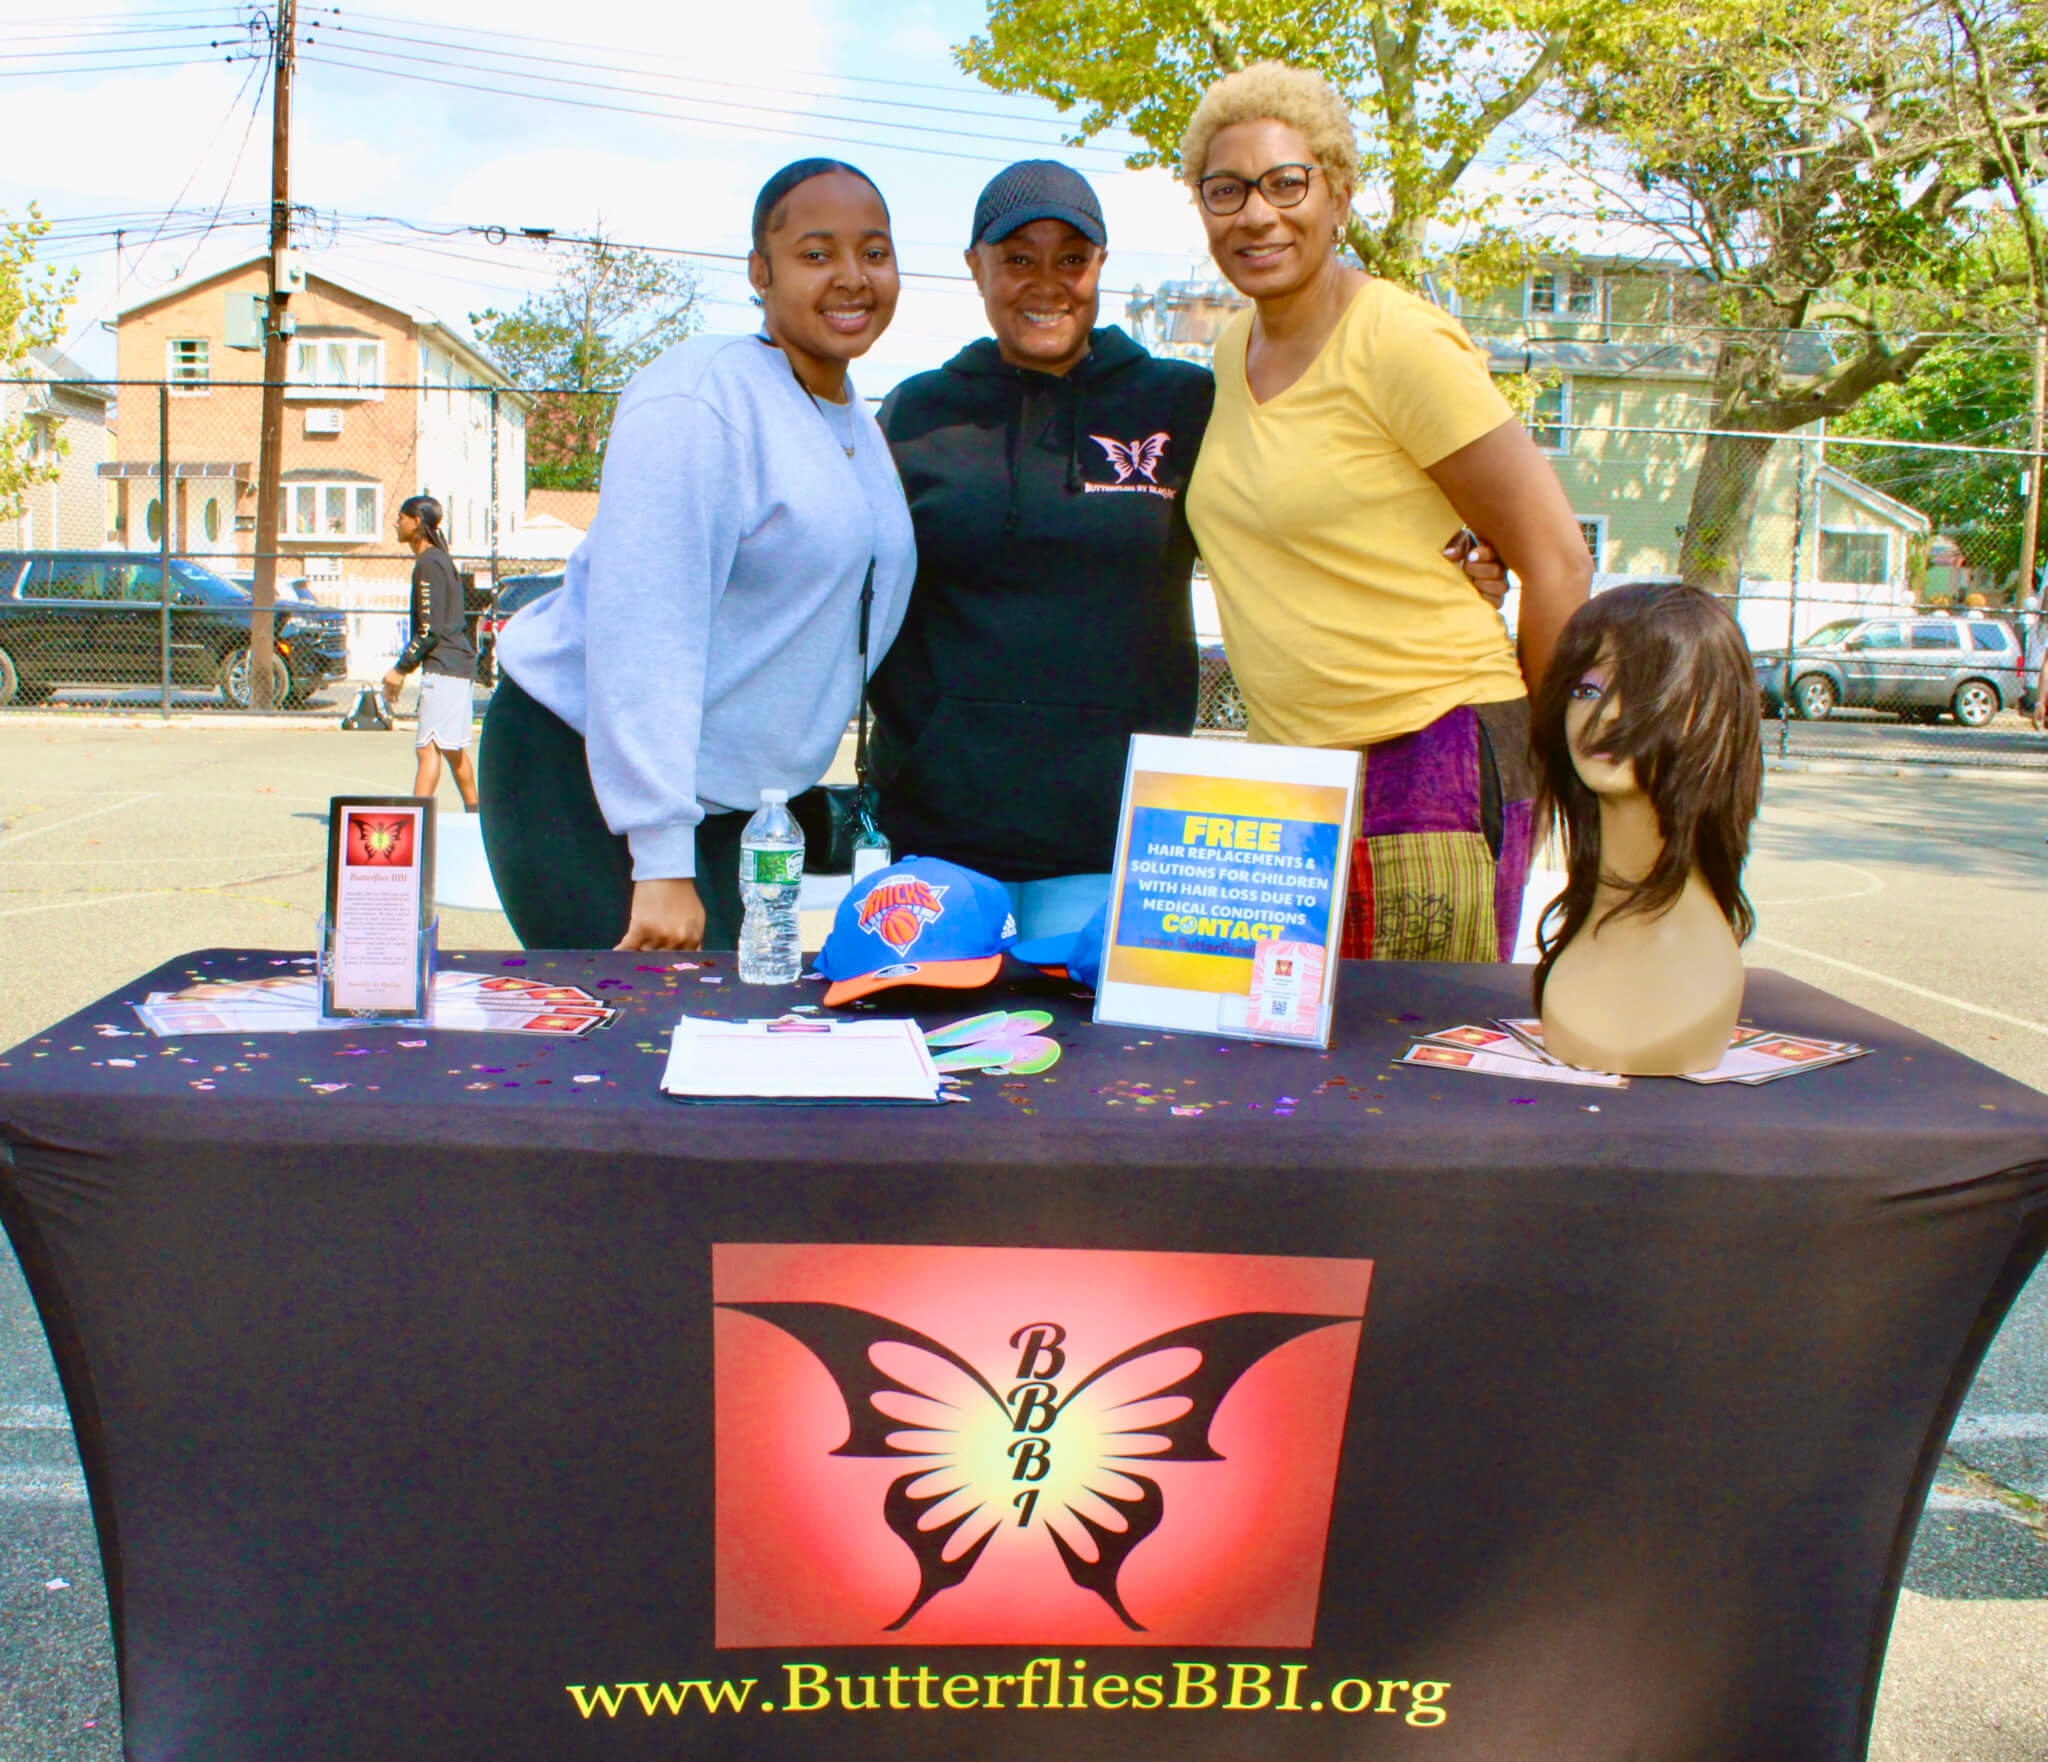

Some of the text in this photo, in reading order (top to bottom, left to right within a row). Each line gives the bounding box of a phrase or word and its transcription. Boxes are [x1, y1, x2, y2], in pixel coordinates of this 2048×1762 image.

[421, 581, 431, 615] JUST
[1183, 815, 1282, 852] FREE
[1147, 843, 1316, 870] HAIR REPLACEMENTS &
[1131, 860, 1328, 890] SOLUTIONS FOR CHILDREN
[860, 882, 942, 925] KNICKS
[1139, 880, 1316, 907] WITH HAIR LOSS DUE TO
[1143, 898, 1306, 925] MEDICAL CONDITIONS
[1162, 914, 1285, 942] CONTACT
[566, 1657, 1452, 1727] www.ButterfliesBBI.org
